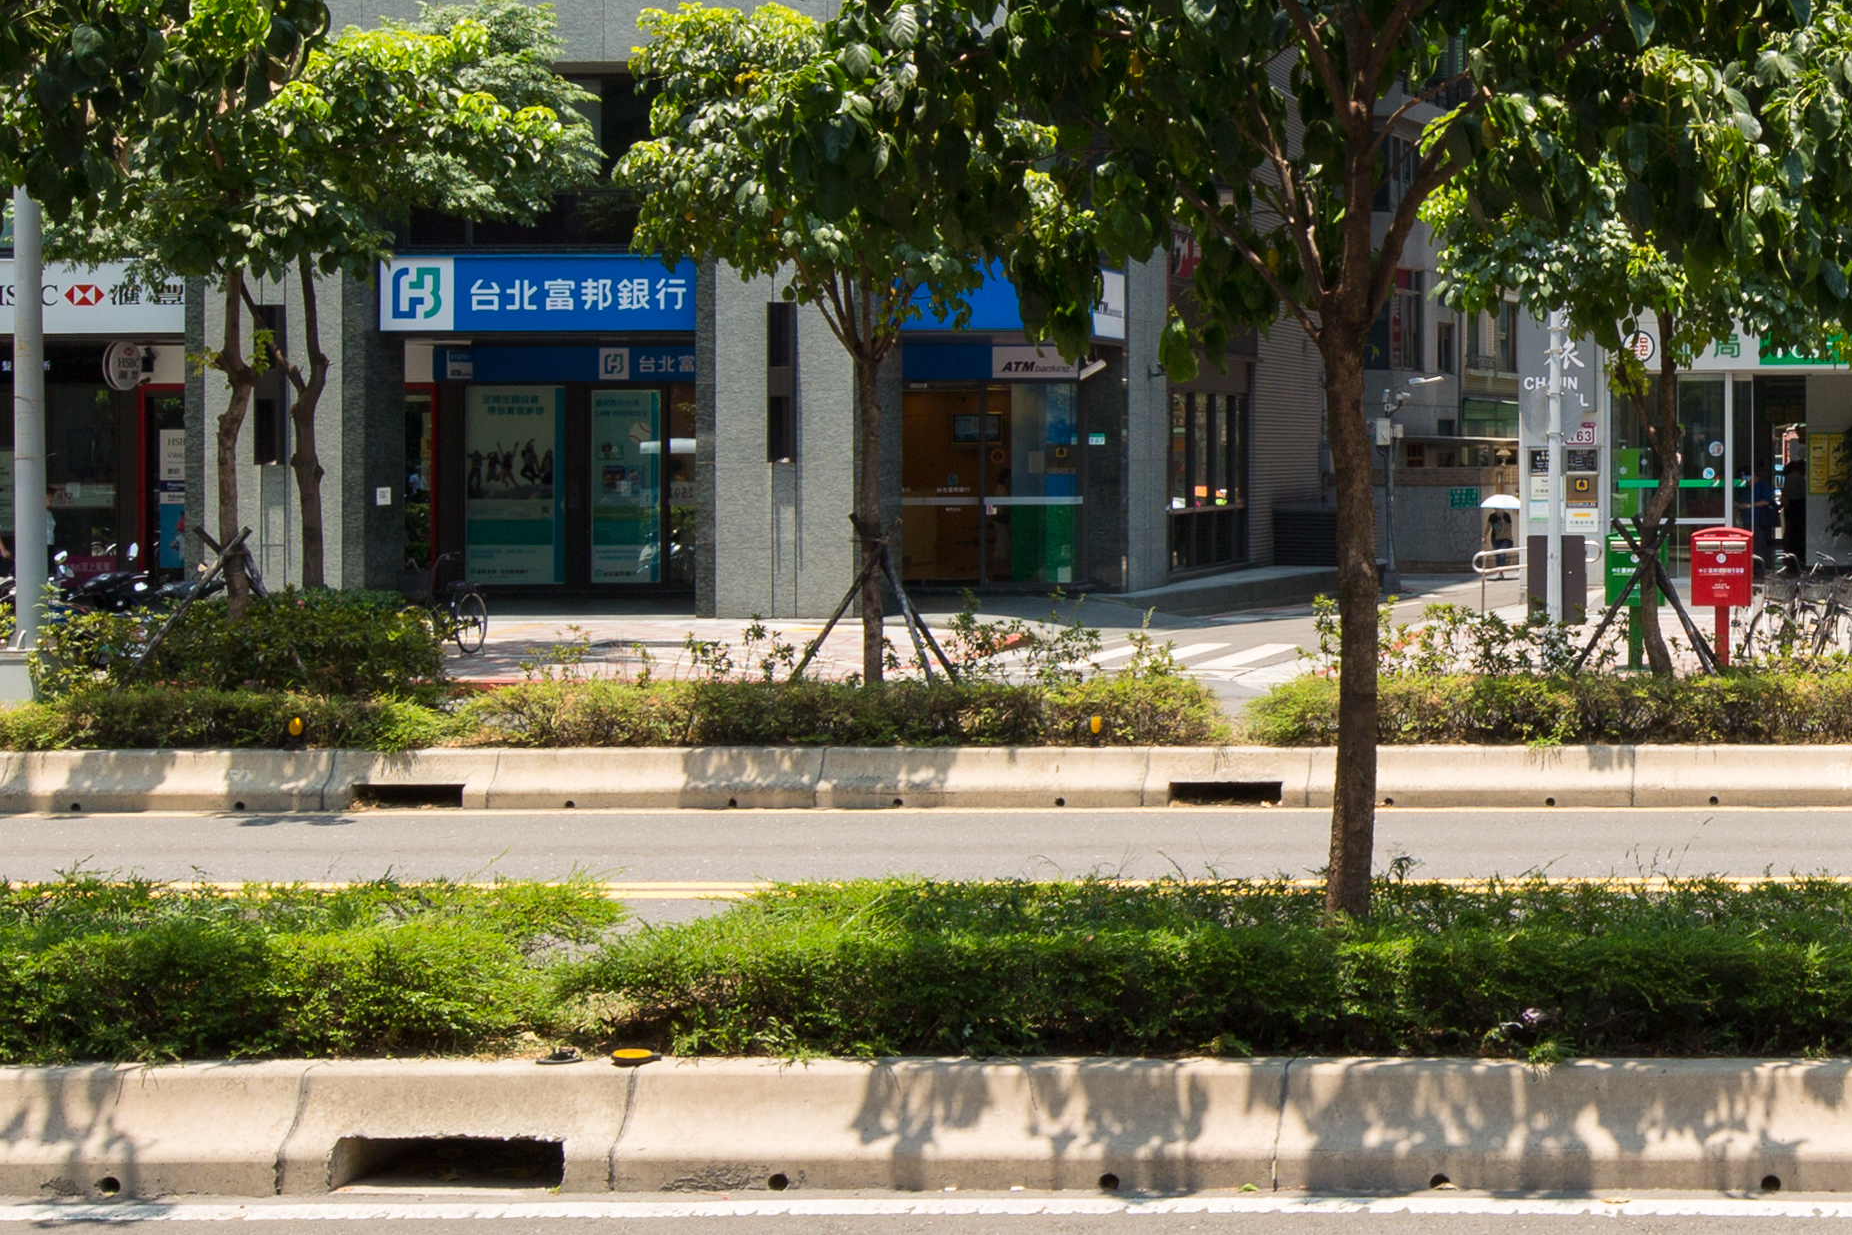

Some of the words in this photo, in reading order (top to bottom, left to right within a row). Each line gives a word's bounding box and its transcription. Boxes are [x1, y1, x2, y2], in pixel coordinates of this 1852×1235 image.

[469, 278, 687, 312] 台北富邦銀行
[1002, 361, 1036, 373] ATM
[1035, 363, 1071, 374] banking
